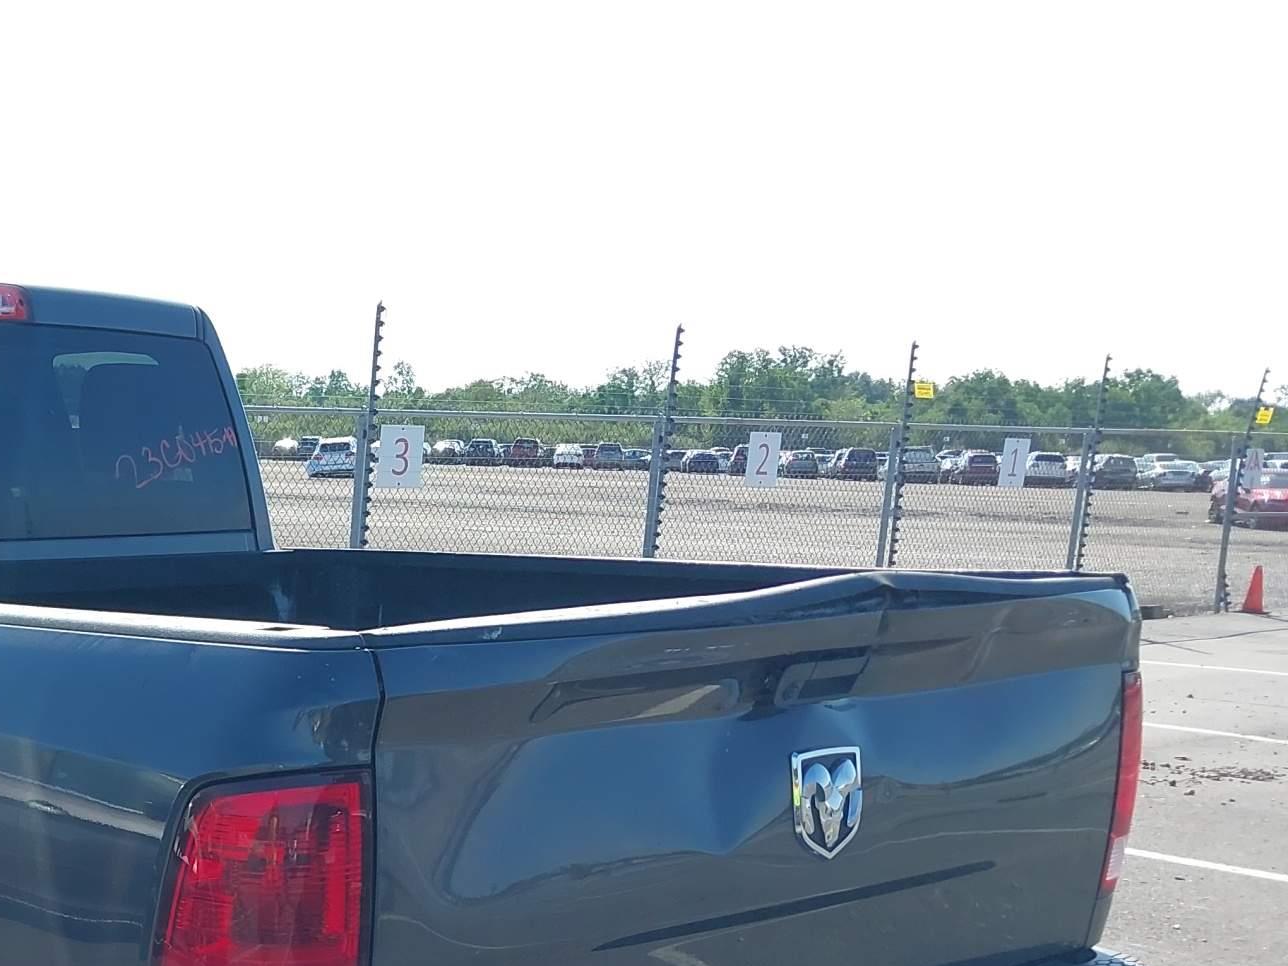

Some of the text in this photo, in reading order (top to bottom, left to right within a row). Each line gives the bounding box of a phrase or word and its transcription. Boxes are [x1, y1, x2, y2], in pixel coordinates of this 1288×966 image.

[391, 437, 410, 476] 3
[755, 443, 770, 476] 2
[1007, 447, 1018, 477] 1
